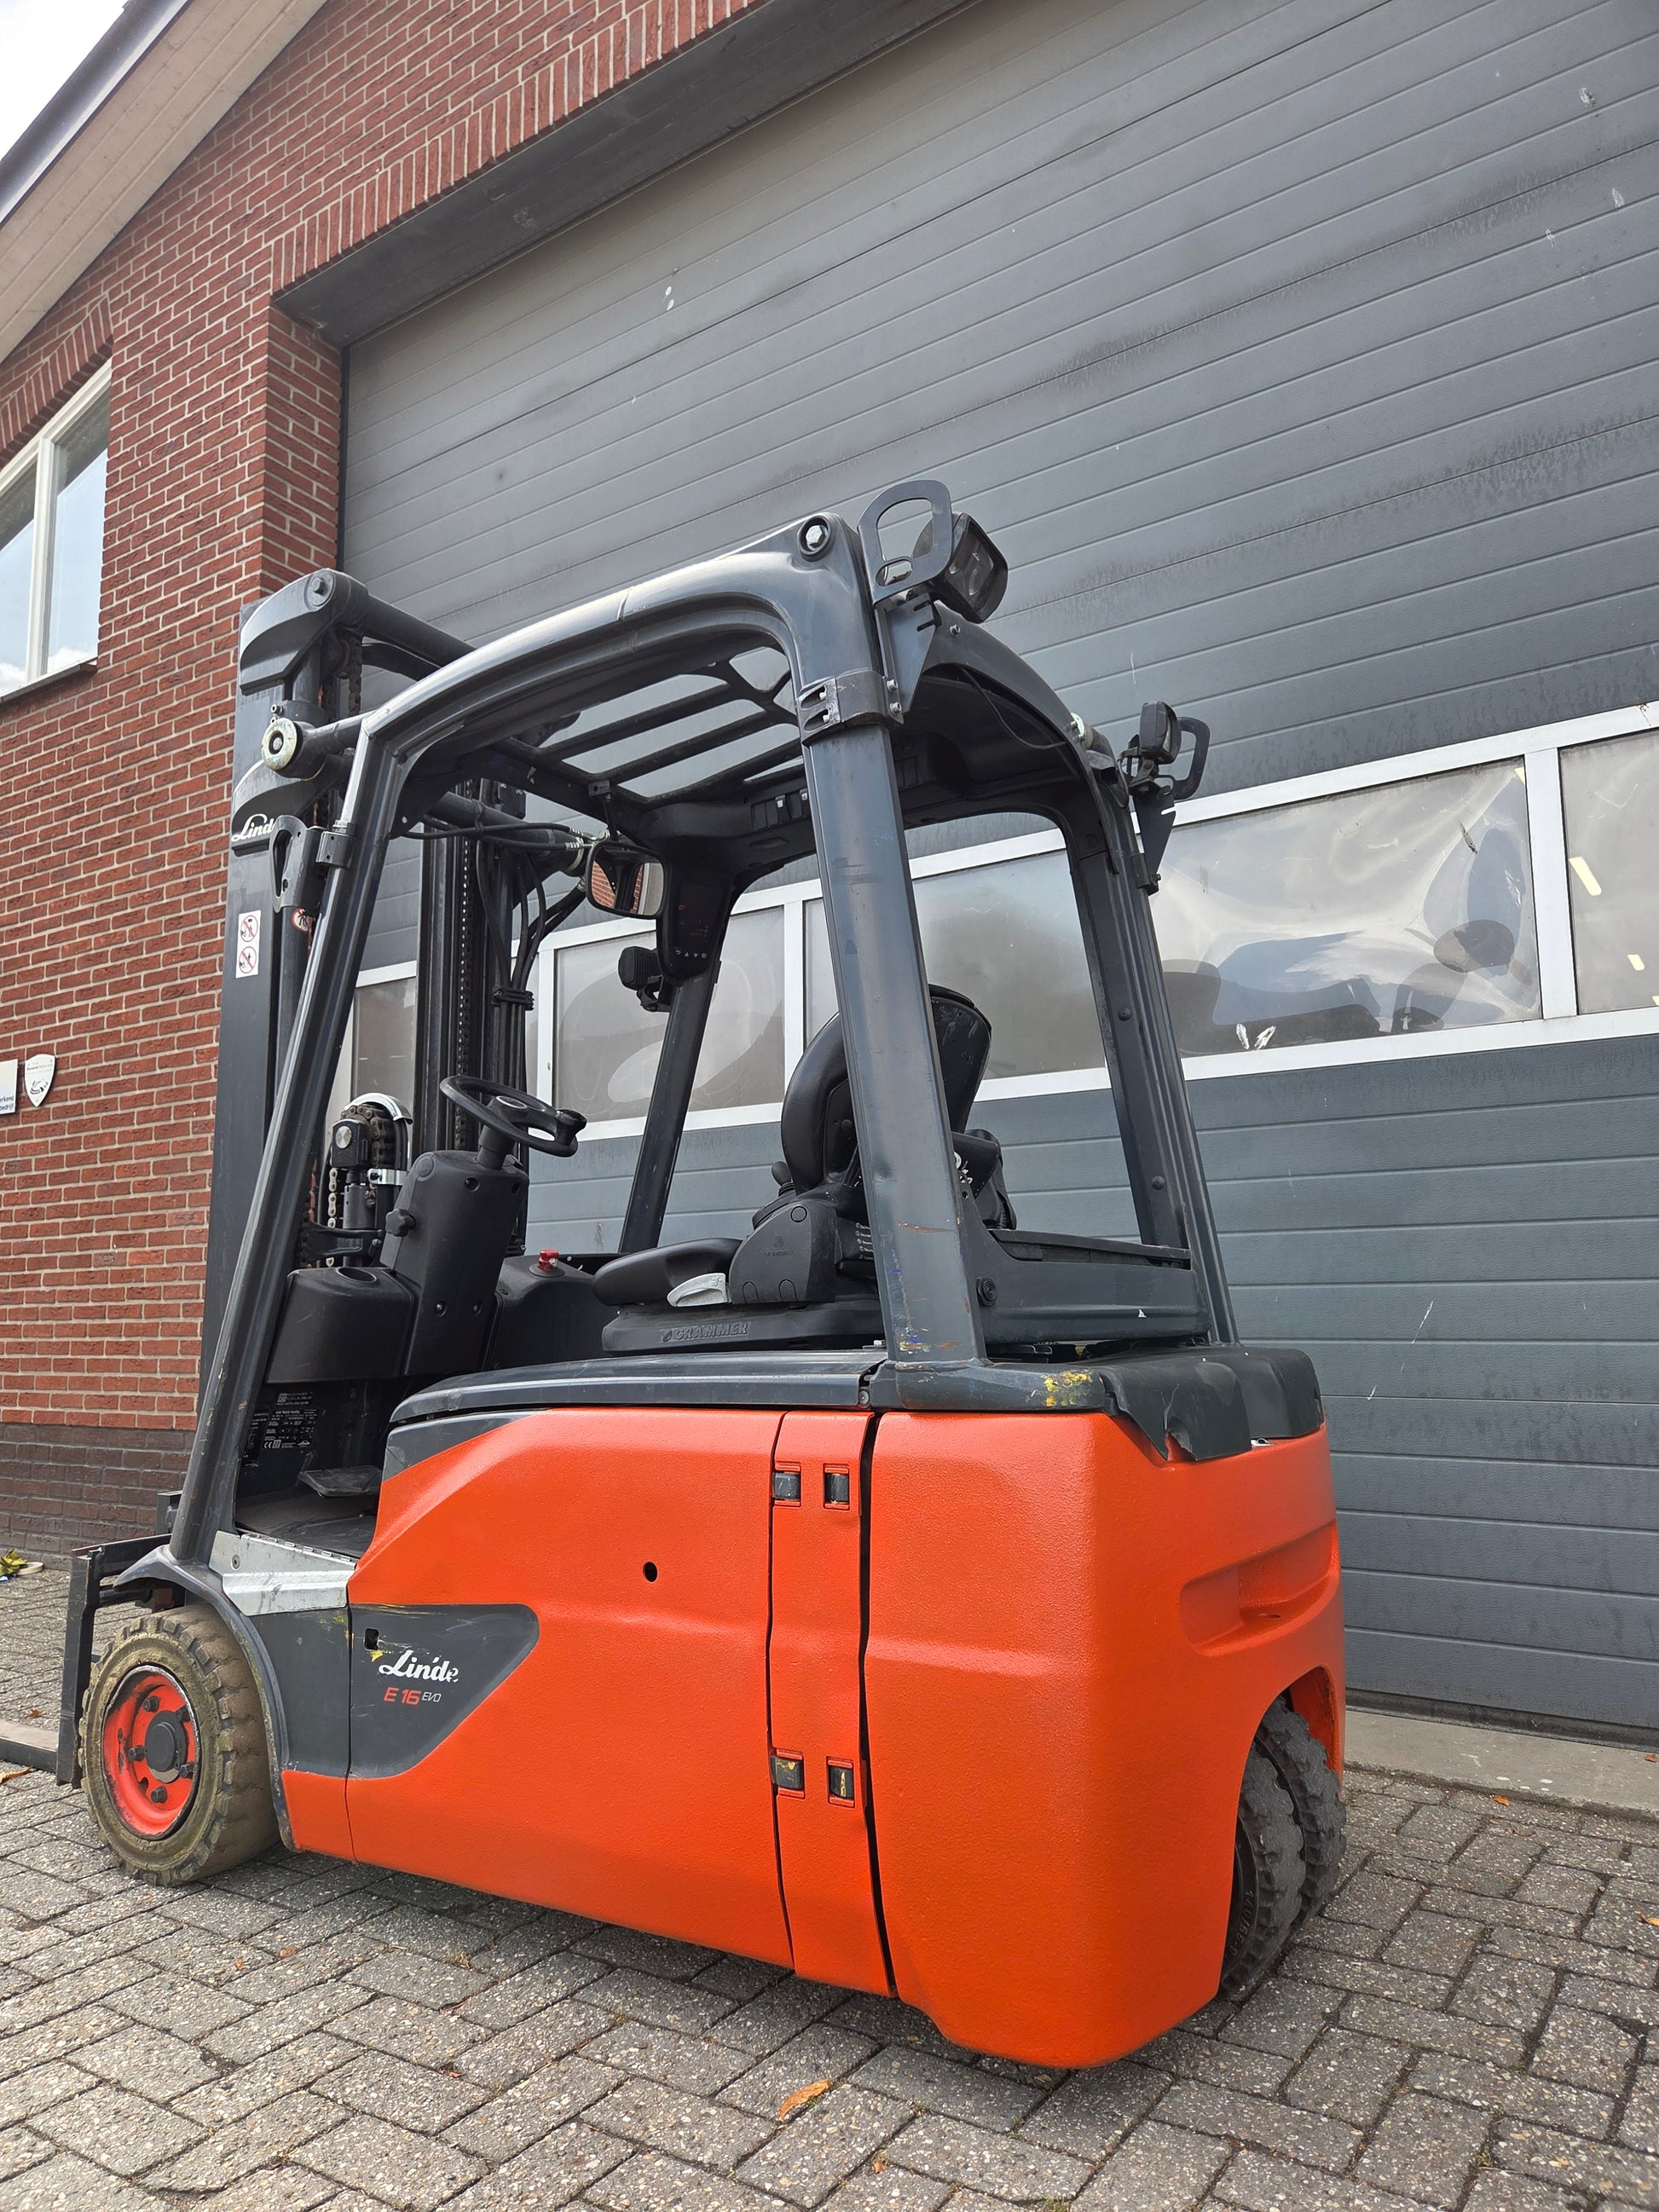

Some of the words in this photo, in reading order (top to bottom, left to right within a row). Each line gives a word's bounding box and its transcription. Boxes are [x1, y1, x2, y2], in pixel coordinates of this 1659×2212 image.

[231, 813, 275, 842] Lind
[675, 1322, 749, 1340] GRAMMER
[379, 1649, 459, 1683] Linde
[422, 1692, 442, 1702] EVO
